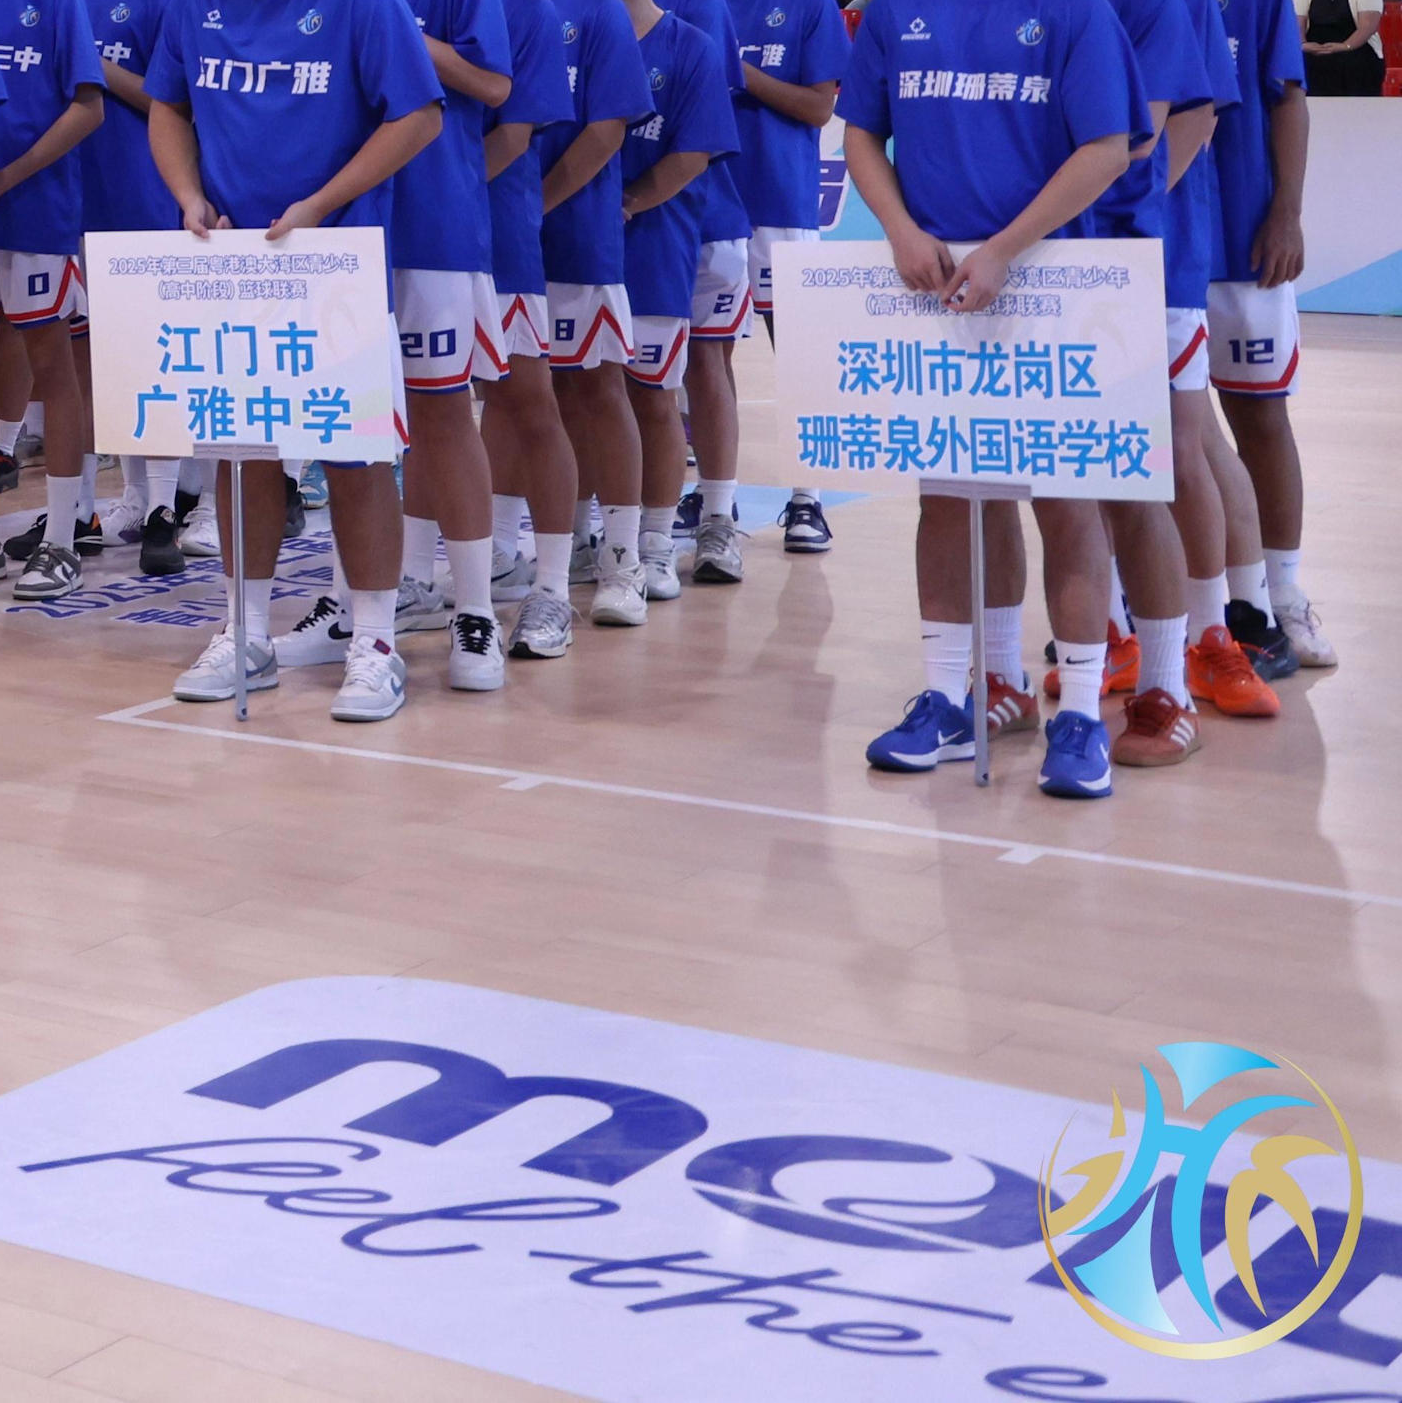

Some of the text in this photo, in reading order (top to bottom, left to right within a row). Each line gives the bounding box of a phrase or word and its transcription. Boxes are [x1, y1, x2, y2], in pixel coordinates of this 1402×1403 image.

[195, 55, 333, 95] 江门广雅
[898, 69, 1052, 103] 深圳珊蒂泉
[399, 328, 457, 359] 20
[554, 318, 576, 342] 8
[156, 321, 319, 378] 江门市
[637, 344, 663, 365] 3
[1227, 337, 1275, 365] 12
[837, 339, 1102, 399] 深圳市龙岗区
[132, 383, 353, 444] 广雅中学
[797, 413, 1153, 480] 珊蒂泉外国语学校
